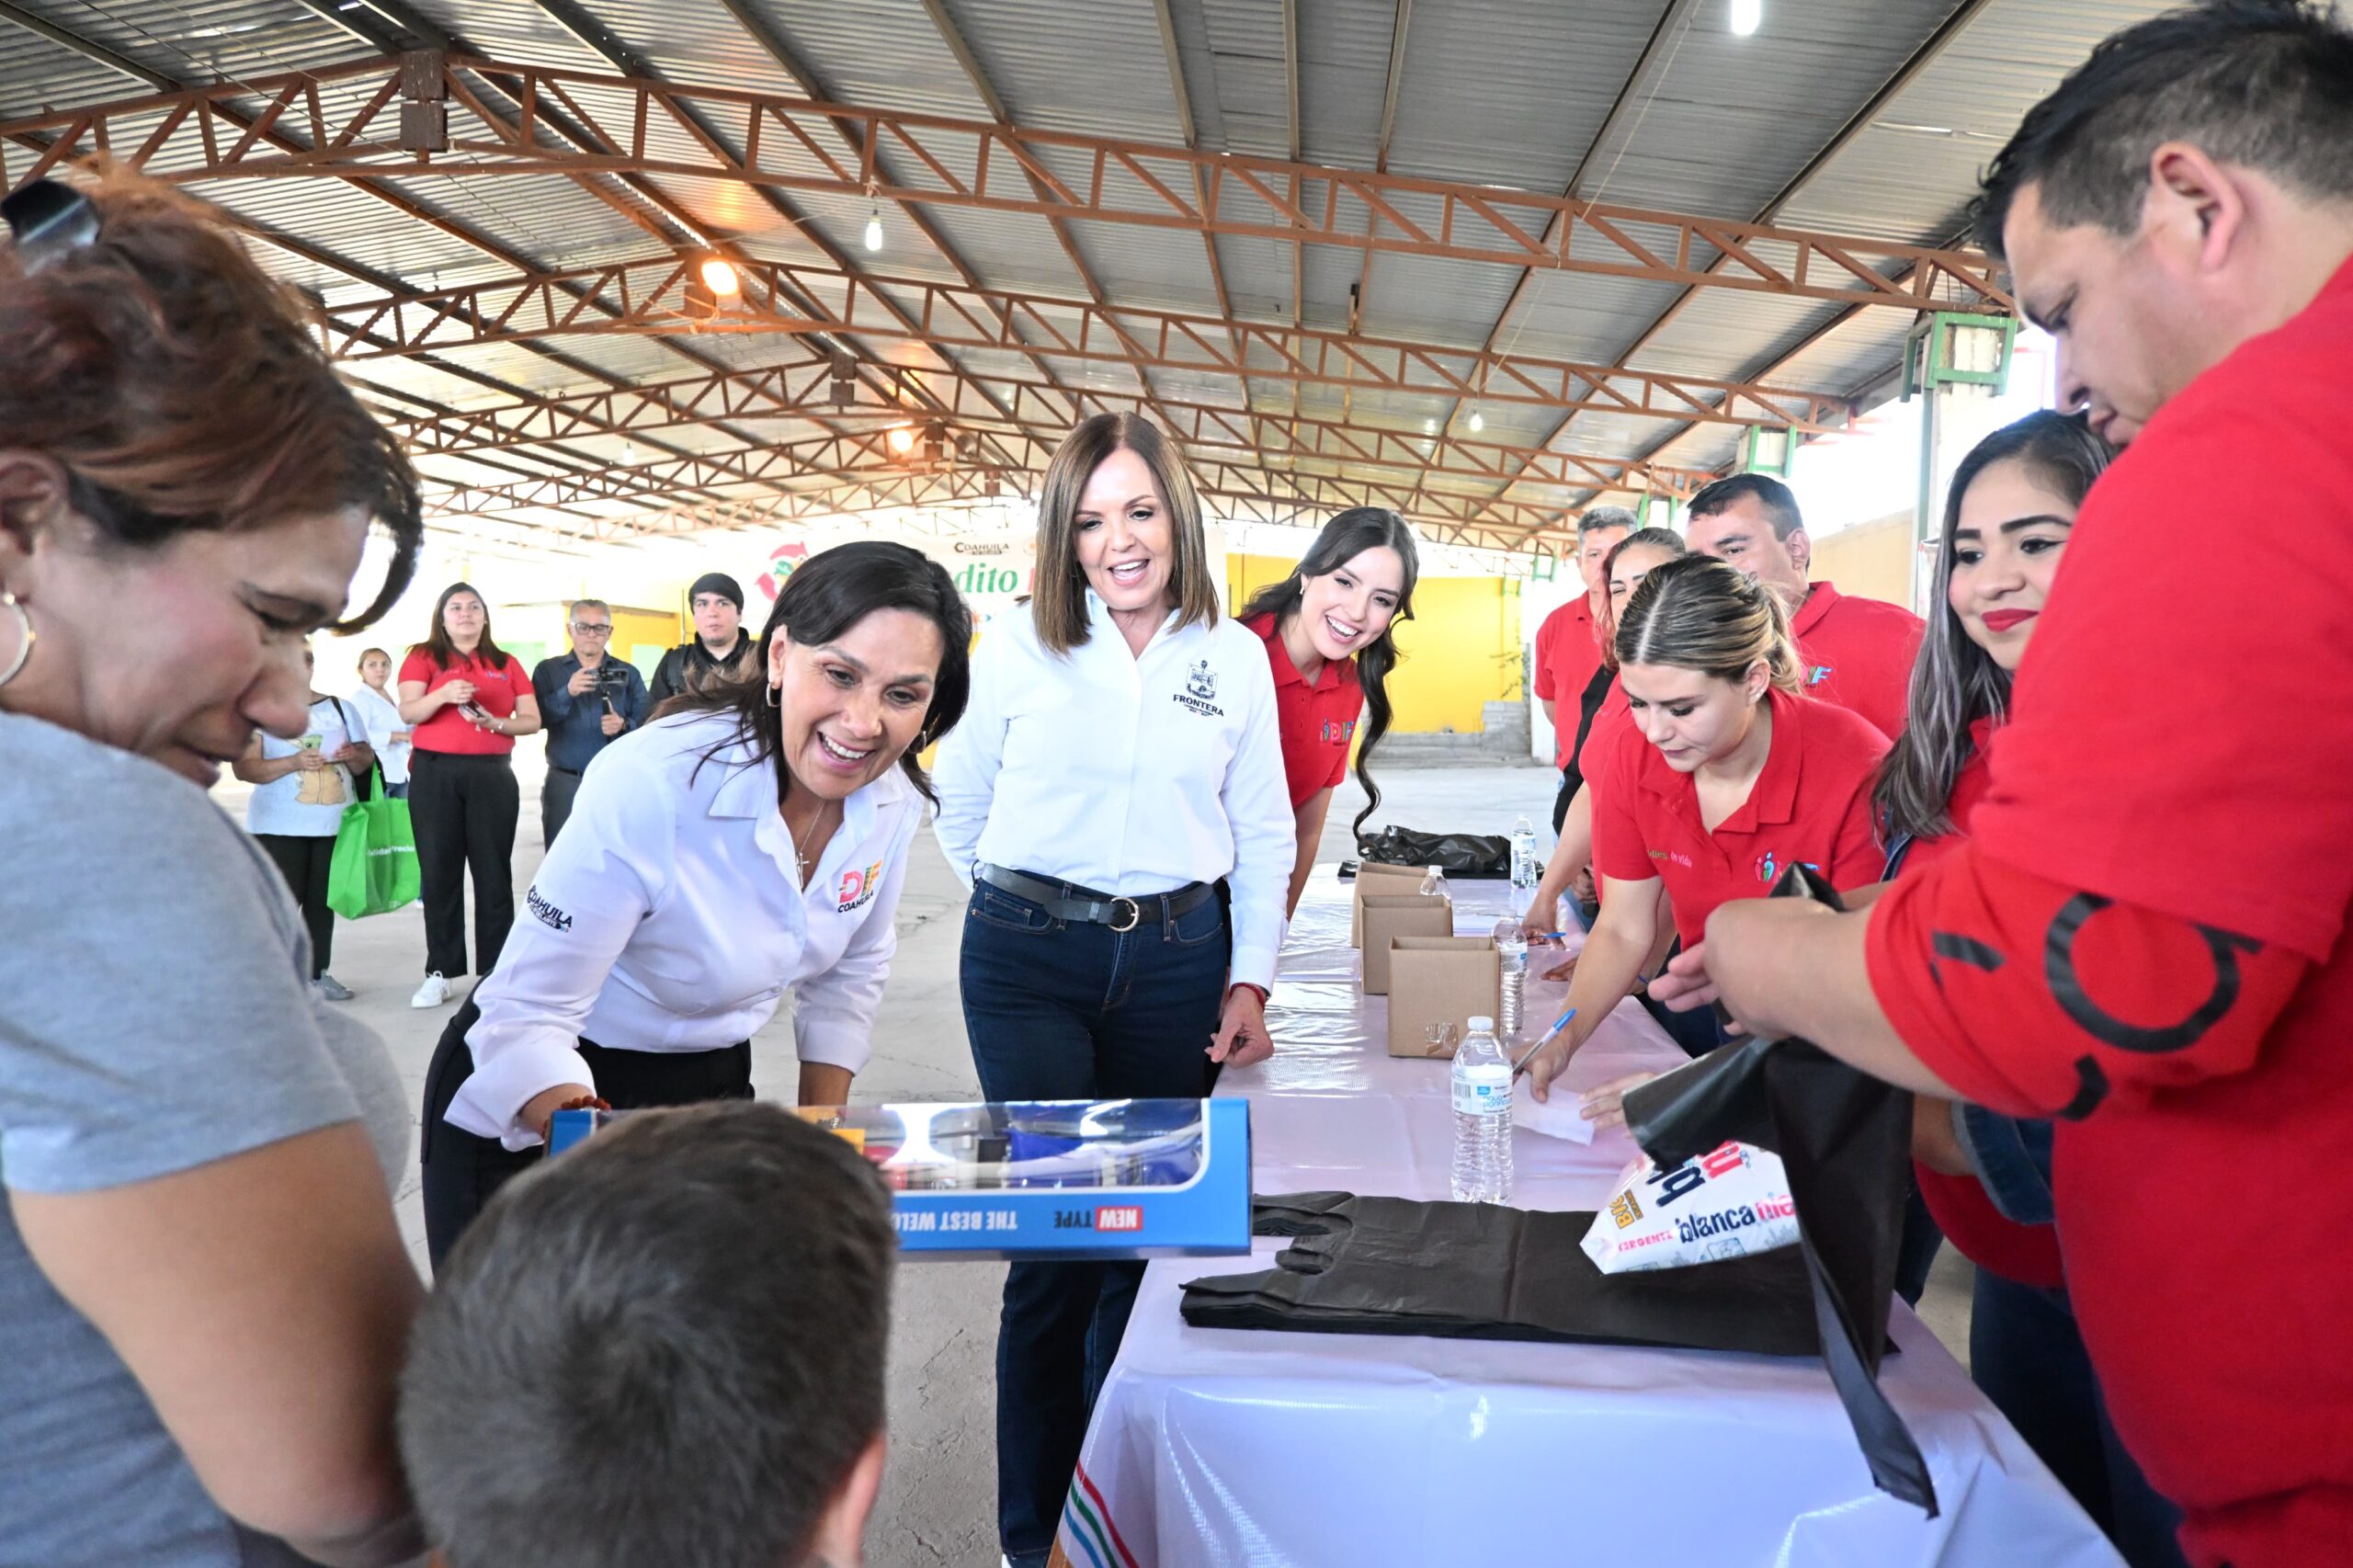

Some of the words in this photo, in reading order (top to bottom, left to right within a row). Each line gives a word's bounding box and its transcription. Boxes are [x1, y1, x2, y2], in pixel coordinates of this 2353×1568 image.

[954, 542, 1009, 553] COAHUILA
[1173, 694, 1224, 717] FRONTERA
[838, 859, 882, 903] DIF
[527, 884, 573, 928] COAHUILA
[837, 890, 874, 914] COAHUILA
[939, 1211, 983, 1232] BEST
[986, 1210, 1017, 1231] THE
[1053, 1210, 1094, 1229] TYPE
[1098, 1207, 1138, 1228] NEW
[1675, 1205, 1756, 1244] blanca
